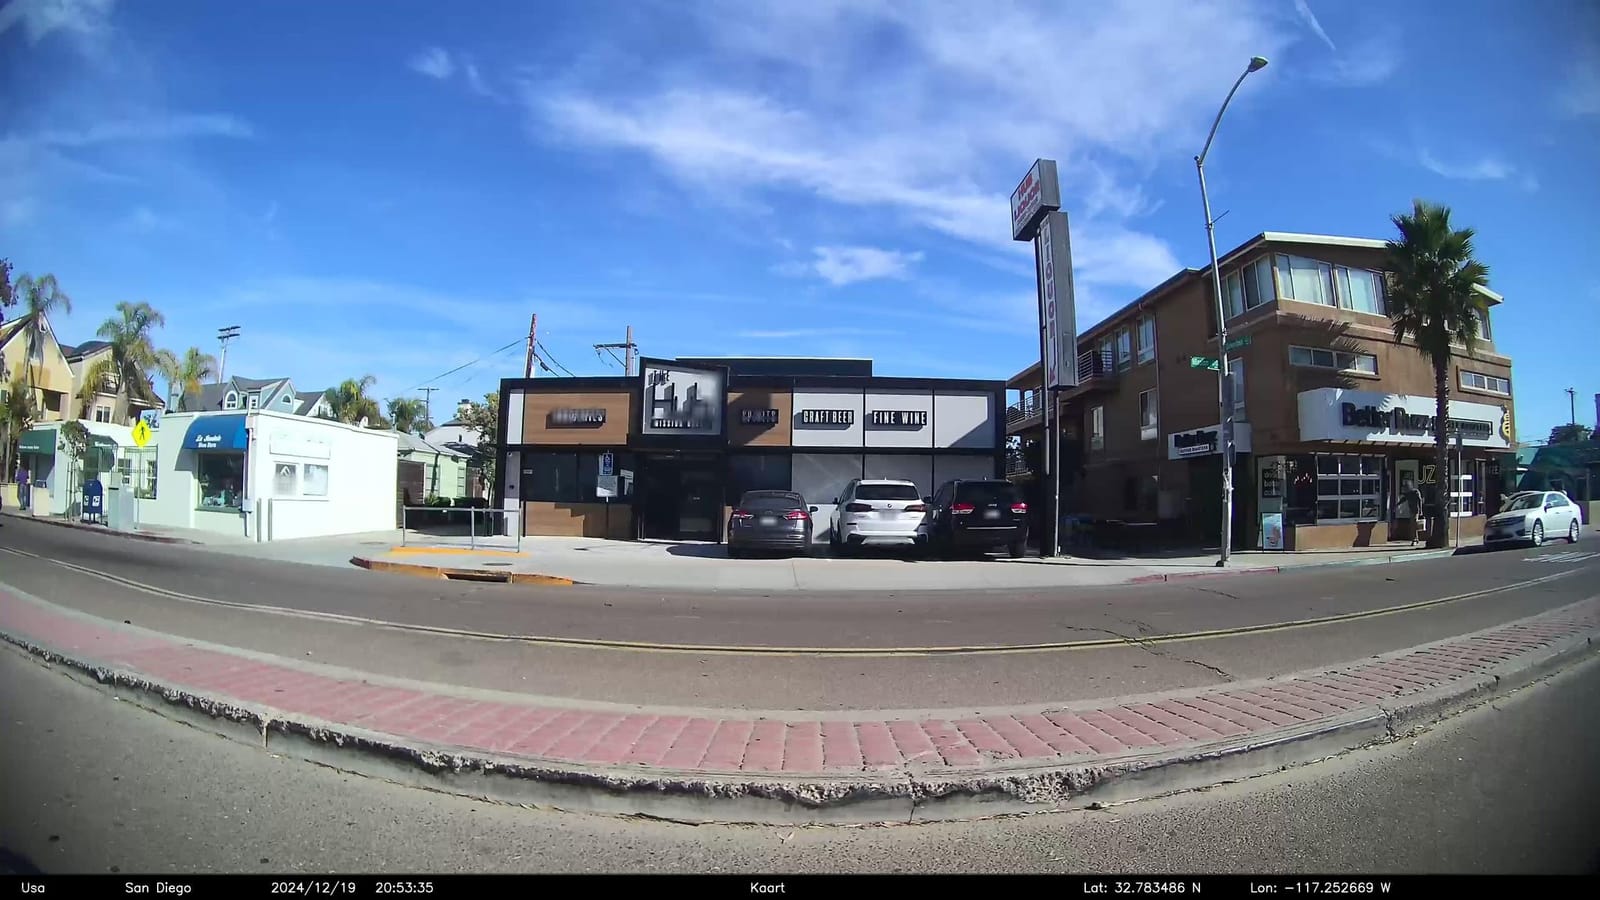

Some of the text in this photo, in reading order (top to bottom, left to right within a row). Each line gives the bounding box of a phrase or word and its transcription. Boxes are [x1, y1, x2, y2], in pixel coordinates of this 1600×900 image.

[803, 410, 853, 424] CRAFT BEER
[873, 411, 926, 424] FINE WINE
